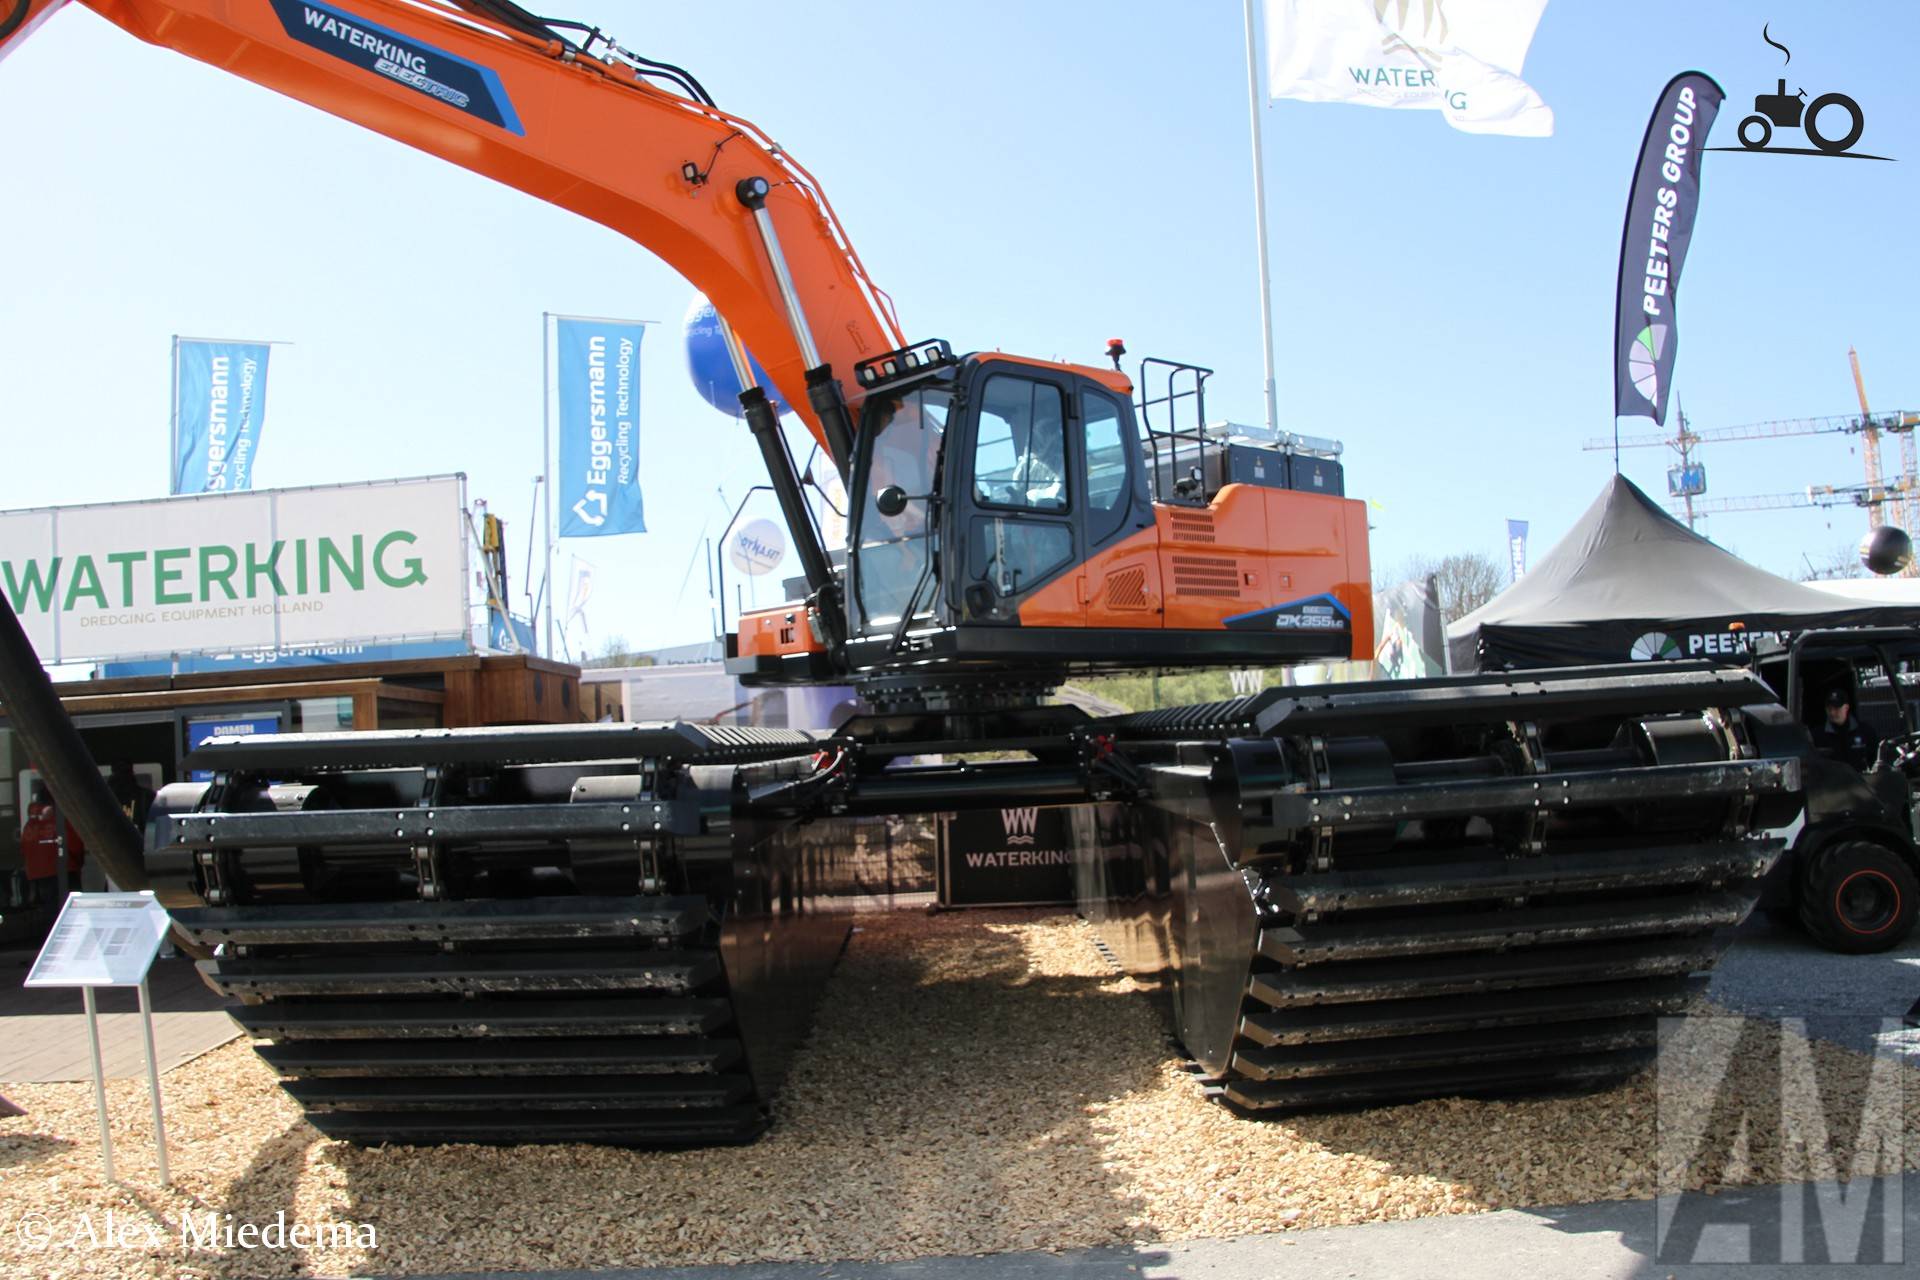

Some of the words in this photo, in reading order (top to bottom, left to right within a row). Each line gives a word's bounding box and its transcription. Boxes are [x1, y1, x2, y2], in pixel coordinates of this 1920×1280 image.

[304, 7, 427, 75] WATERKING
[1643, 187, 1677, 316] PEETERS
[1662, 86, 1697, 183] GROUP
[587, 336, 612, 485] Eggersmann
[616, 338, 633, 417] Technology
[206, 356, 230, 491] ggersmann
[615, 421, 632, 485] Recycling
[1, 530, 429, 615] WATERKING
[80, 611, 156, 628] DREDGING
[161, 605, 246, 623] EQUIPMENT
[252, 600, 324, 616] HOLLAND
